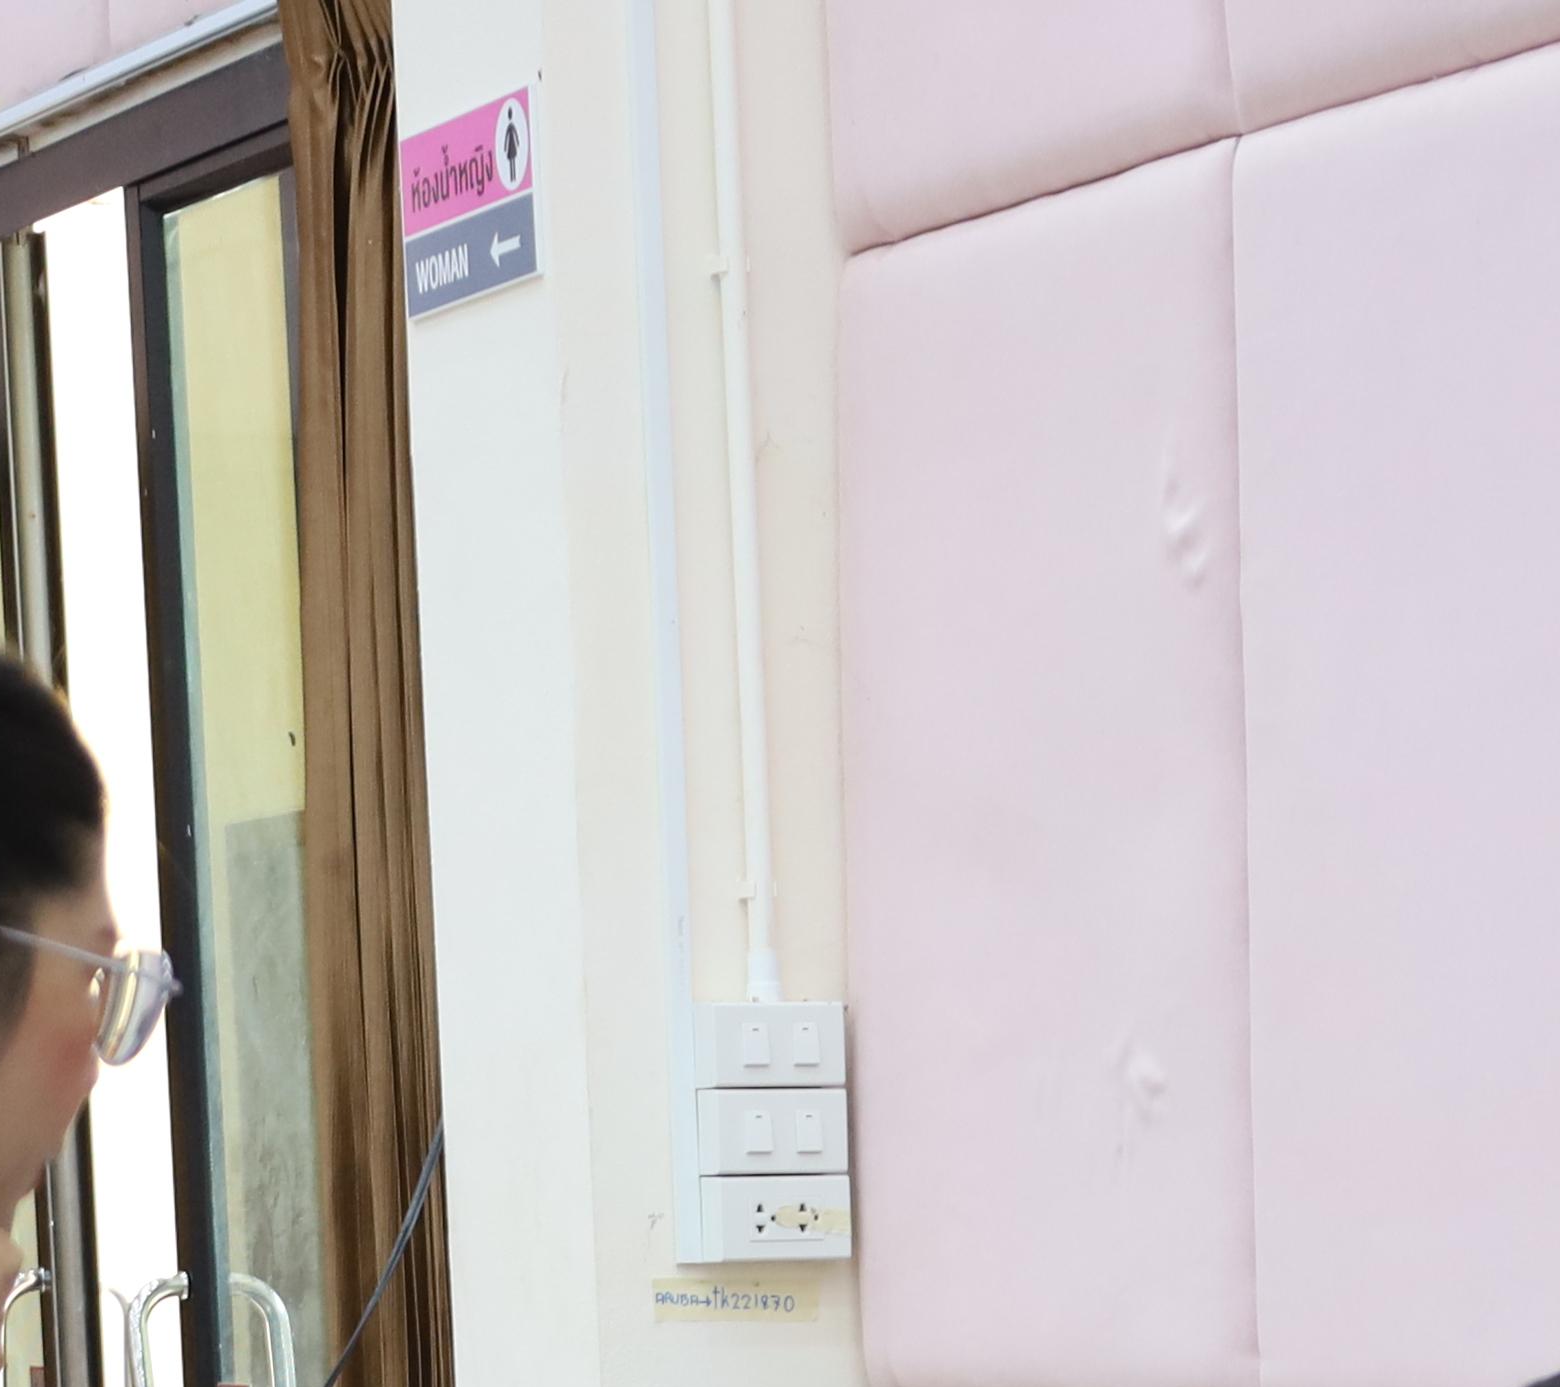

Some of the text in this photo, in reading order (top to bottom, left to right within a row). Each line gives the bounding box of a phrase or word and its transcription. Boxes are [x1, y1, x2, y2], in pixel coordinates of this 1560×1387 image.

[411, 144, 494, 213] ห้องน้ำหญิง
[415, 243, 469, 295] WOMAN
